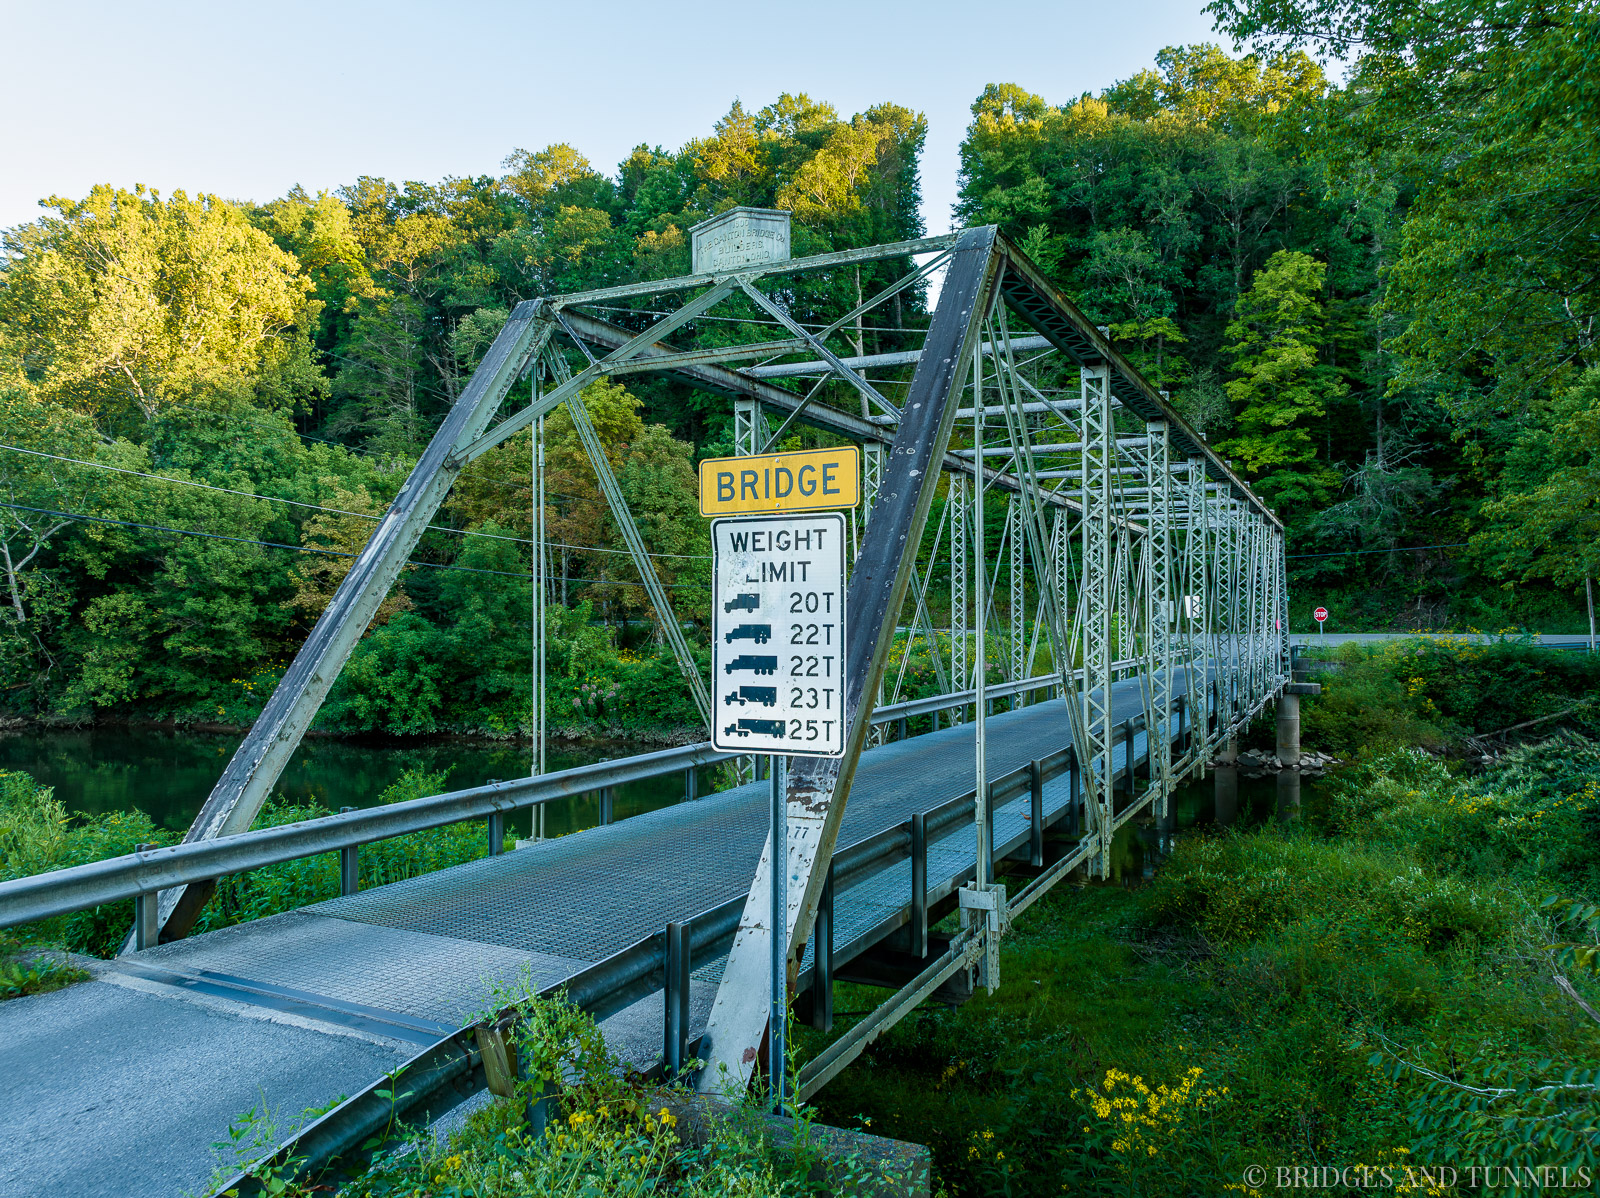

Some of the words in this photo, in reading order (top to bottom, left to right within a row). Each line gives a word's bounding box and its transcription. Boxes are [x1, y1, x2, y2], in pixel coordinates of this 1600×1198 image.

[698, 241, 713, 255] THE
[714, 229, 745, 245] CANTON
[746, 228, 776, 240] BRIDGE
[717, 462, 840, 502] BRIDGE
[730, 529, 827, 552] WEIGHT
[790, 592, 834, 613] 20T
[790, 624, 834, 645] 22T
[790, 655, 834, 677] 22T
[790, 687, 834, 709] 23T
[789, 719, 834, 741] 25T
